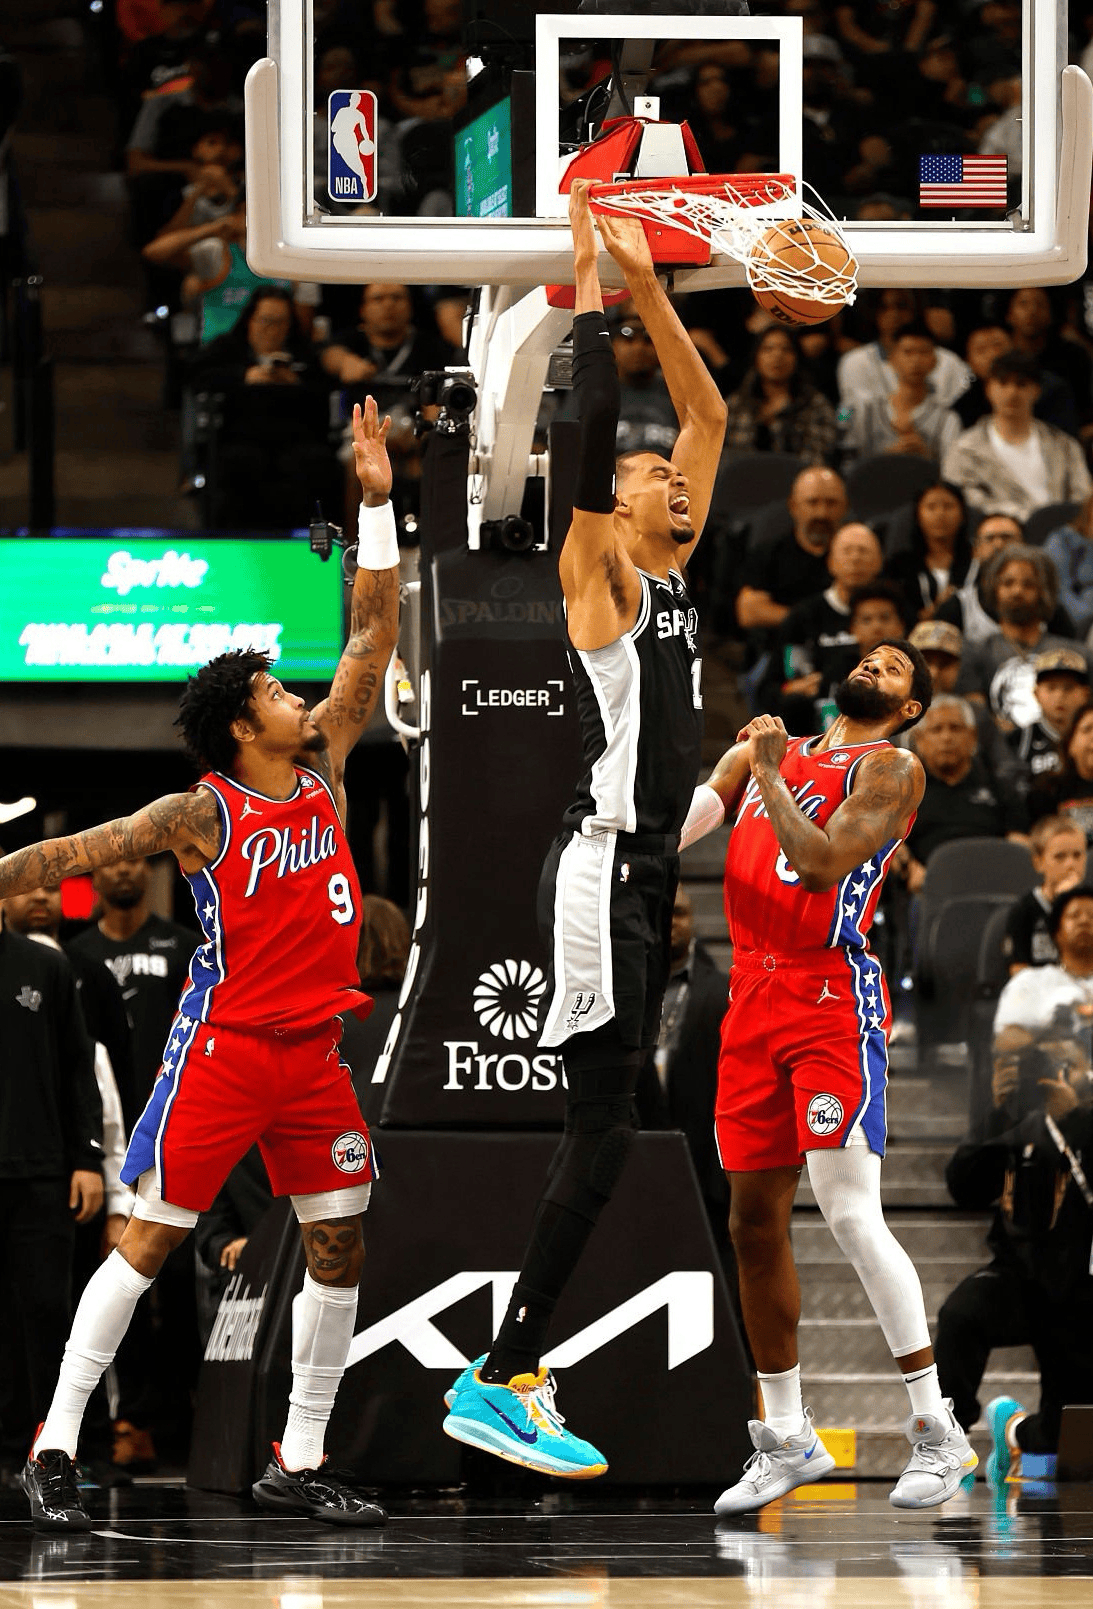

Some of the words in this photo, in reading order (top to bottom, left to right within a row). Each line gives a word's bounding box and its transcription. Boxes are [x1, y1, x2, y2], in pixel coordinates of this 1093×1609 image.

[335, 177, 358, 194] NBA
[476, 689, 550, 706] LEDGER
[241, 815, 337, 897] Phila
[327, 872, 356, 926] 9
[811, 1109, 839, 1125] 76ers
[336, 1147, 366, 1165] 76er
